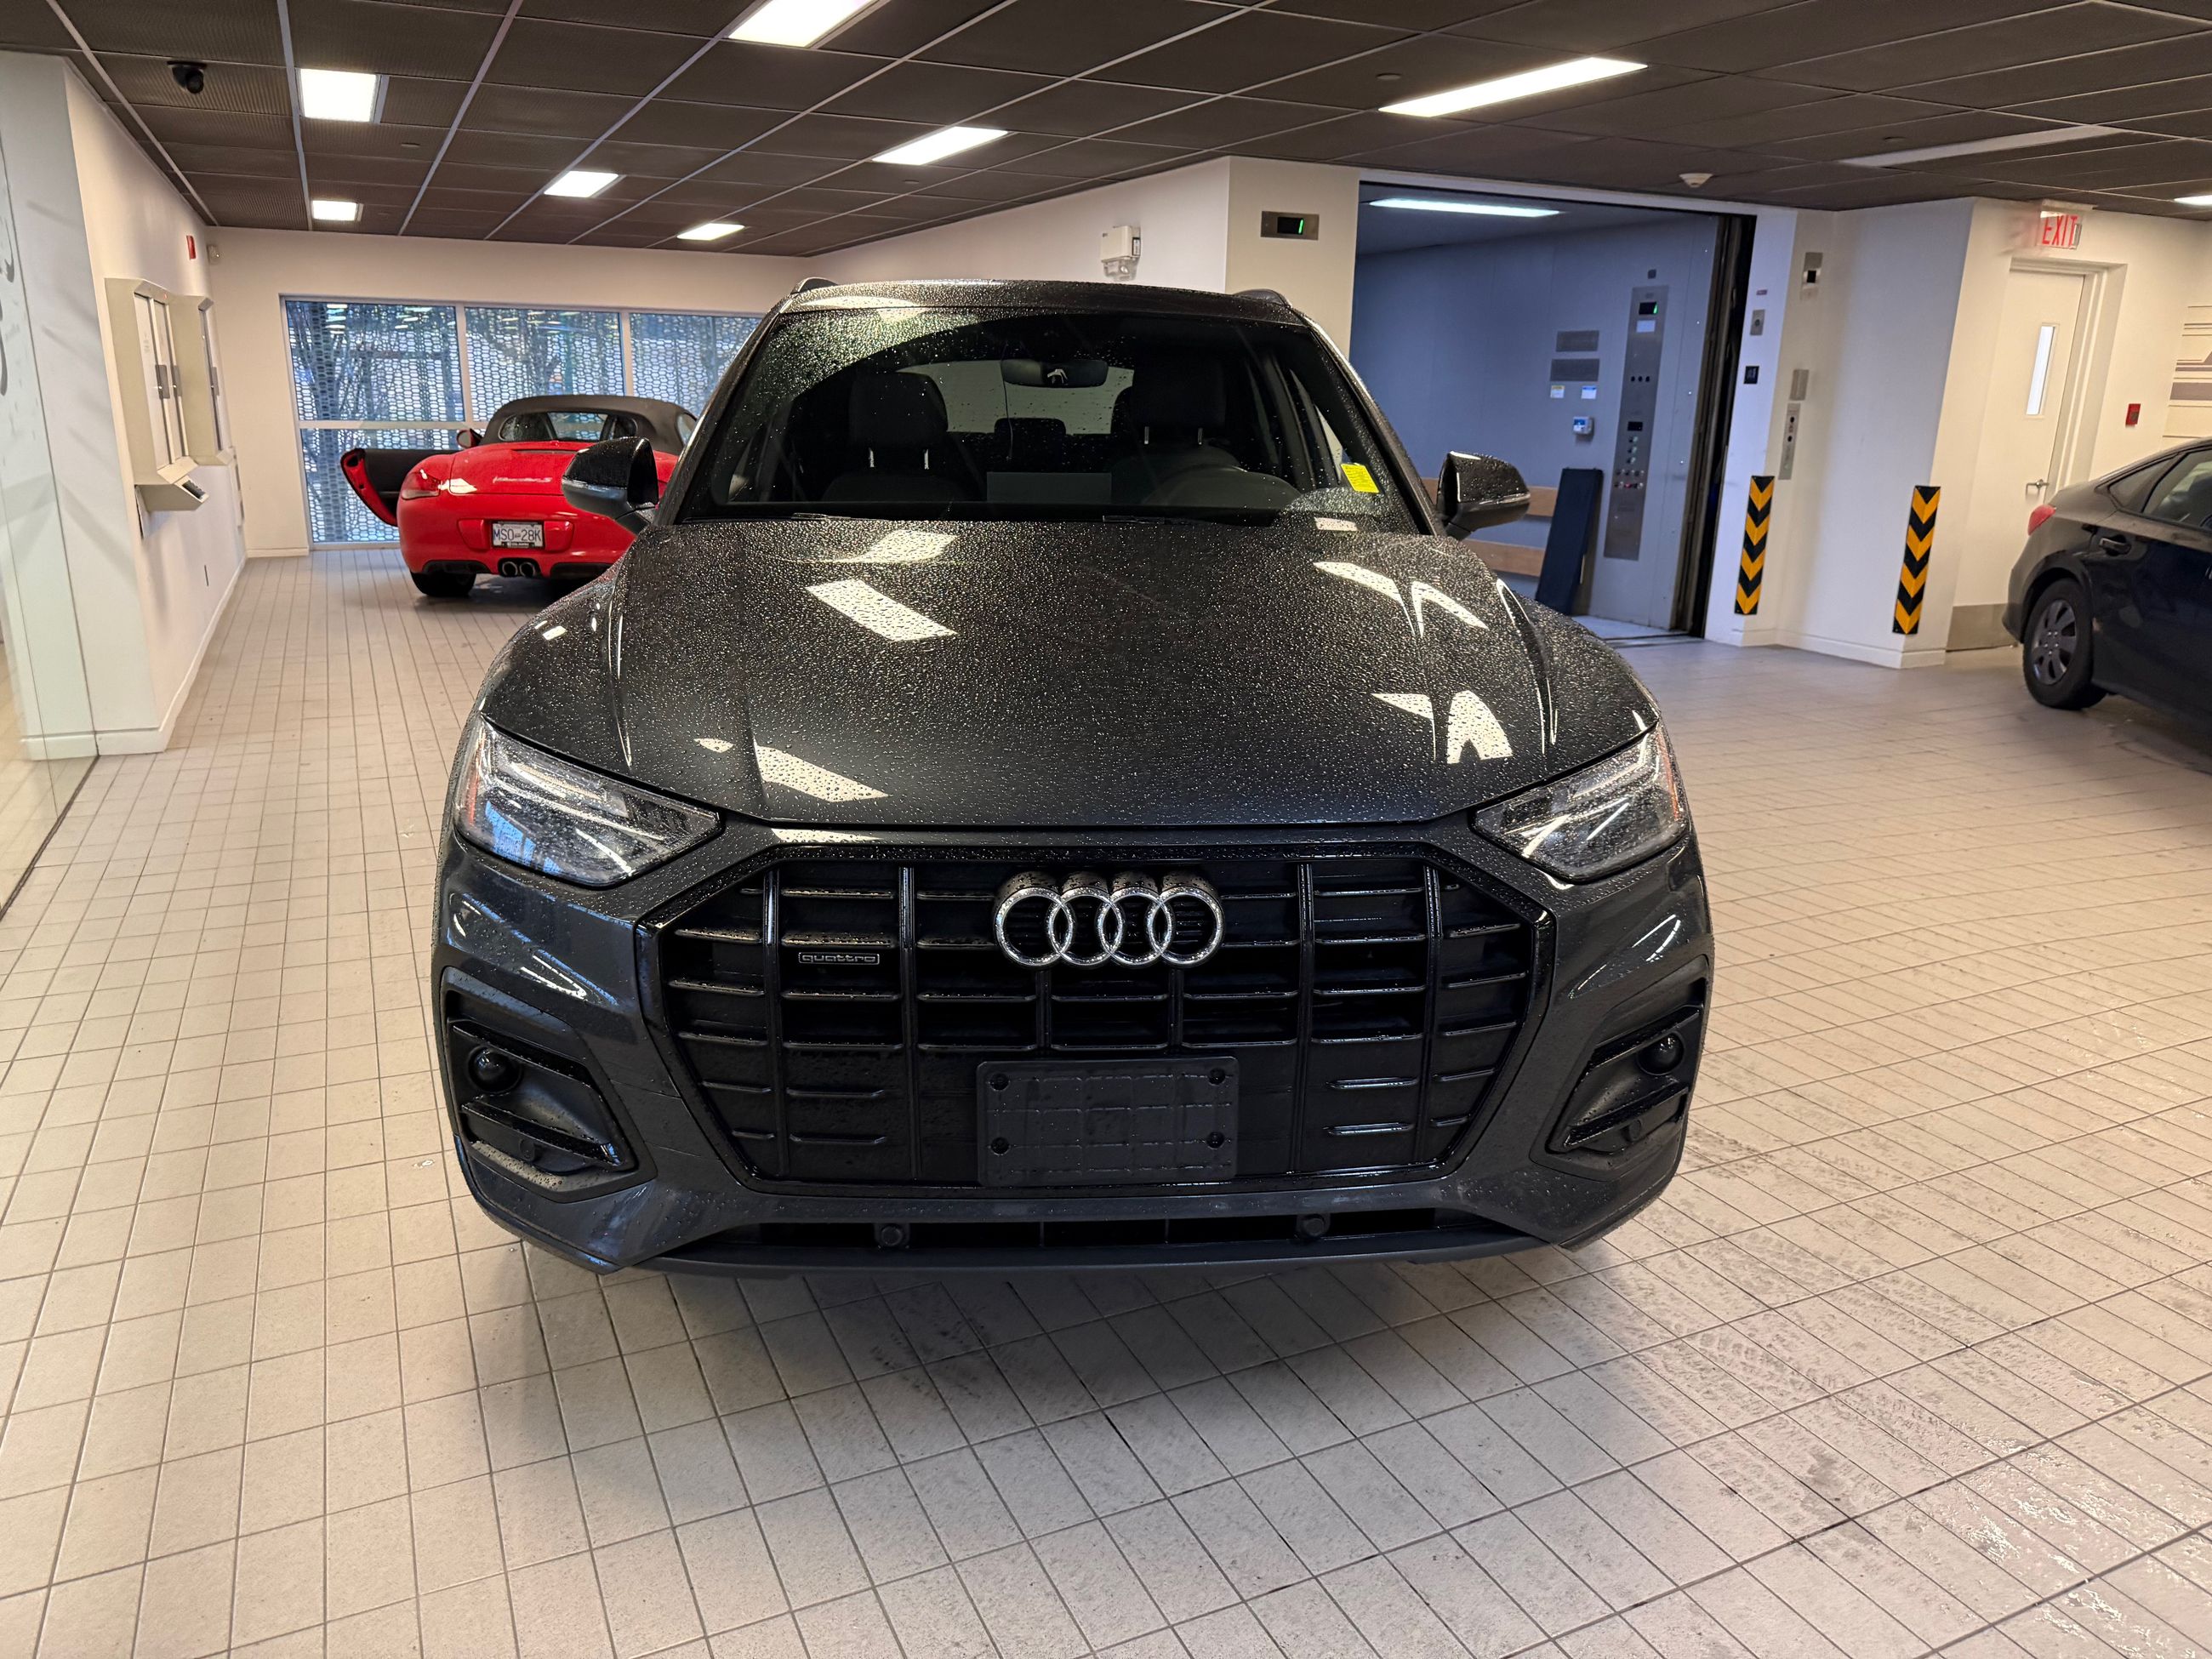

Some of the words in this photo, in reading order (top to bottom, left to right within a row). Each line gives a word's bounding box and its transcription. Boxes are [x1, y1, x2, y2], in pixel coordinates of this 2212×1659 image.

[2042, 214, 2078, 246] EXIT
[521, 529, 541, 542] 28K
[801, 955, 876, 963] quattro
